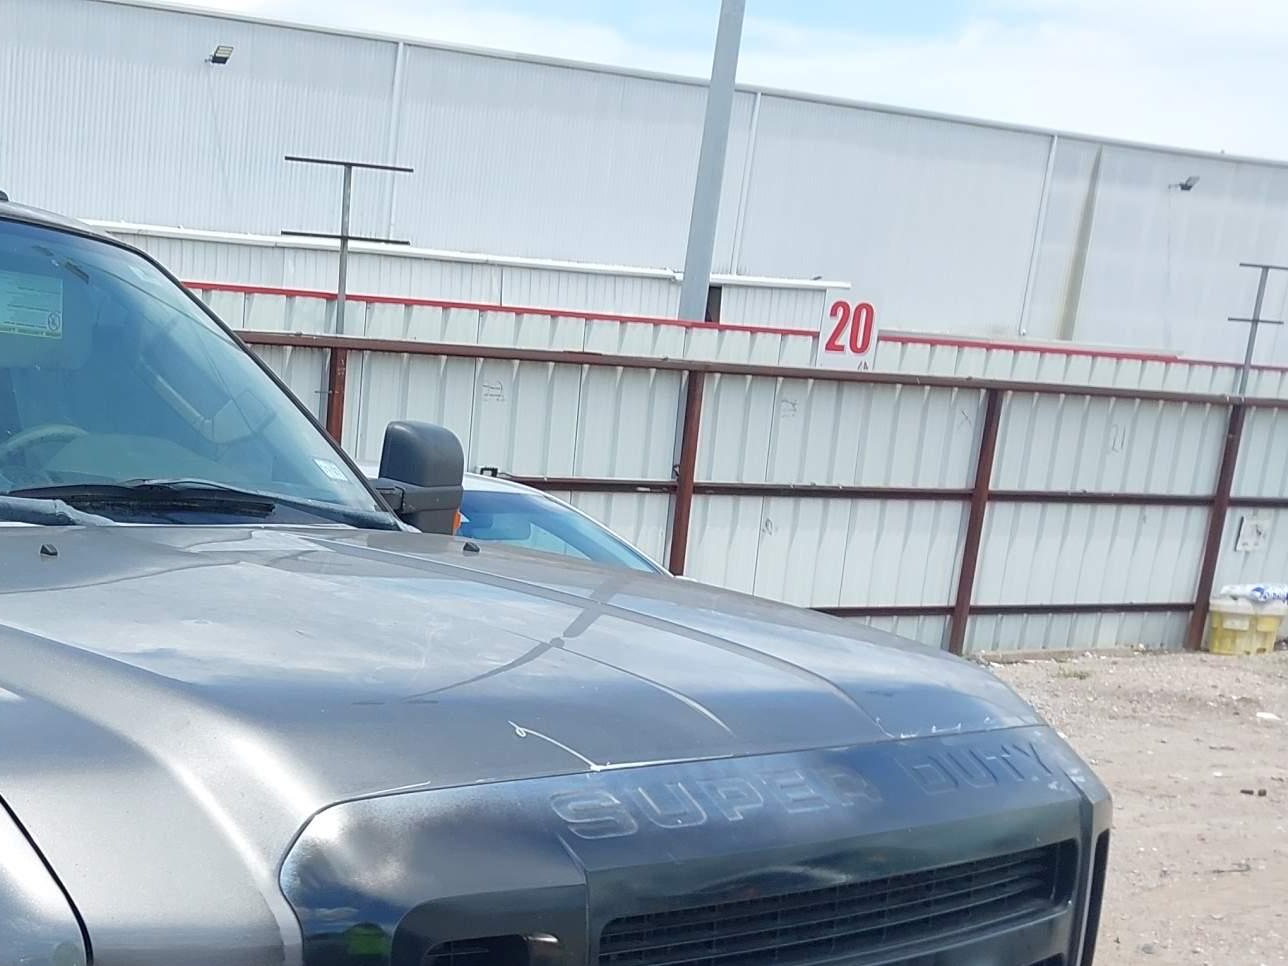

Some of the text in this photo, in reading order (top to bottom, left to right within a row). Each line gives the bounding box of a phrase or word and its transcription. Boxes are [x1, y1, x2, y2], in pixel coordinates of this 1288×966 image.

[825, 301, 874, 353] 20
[550, 743, 1053, 839] SUPER DUTY
